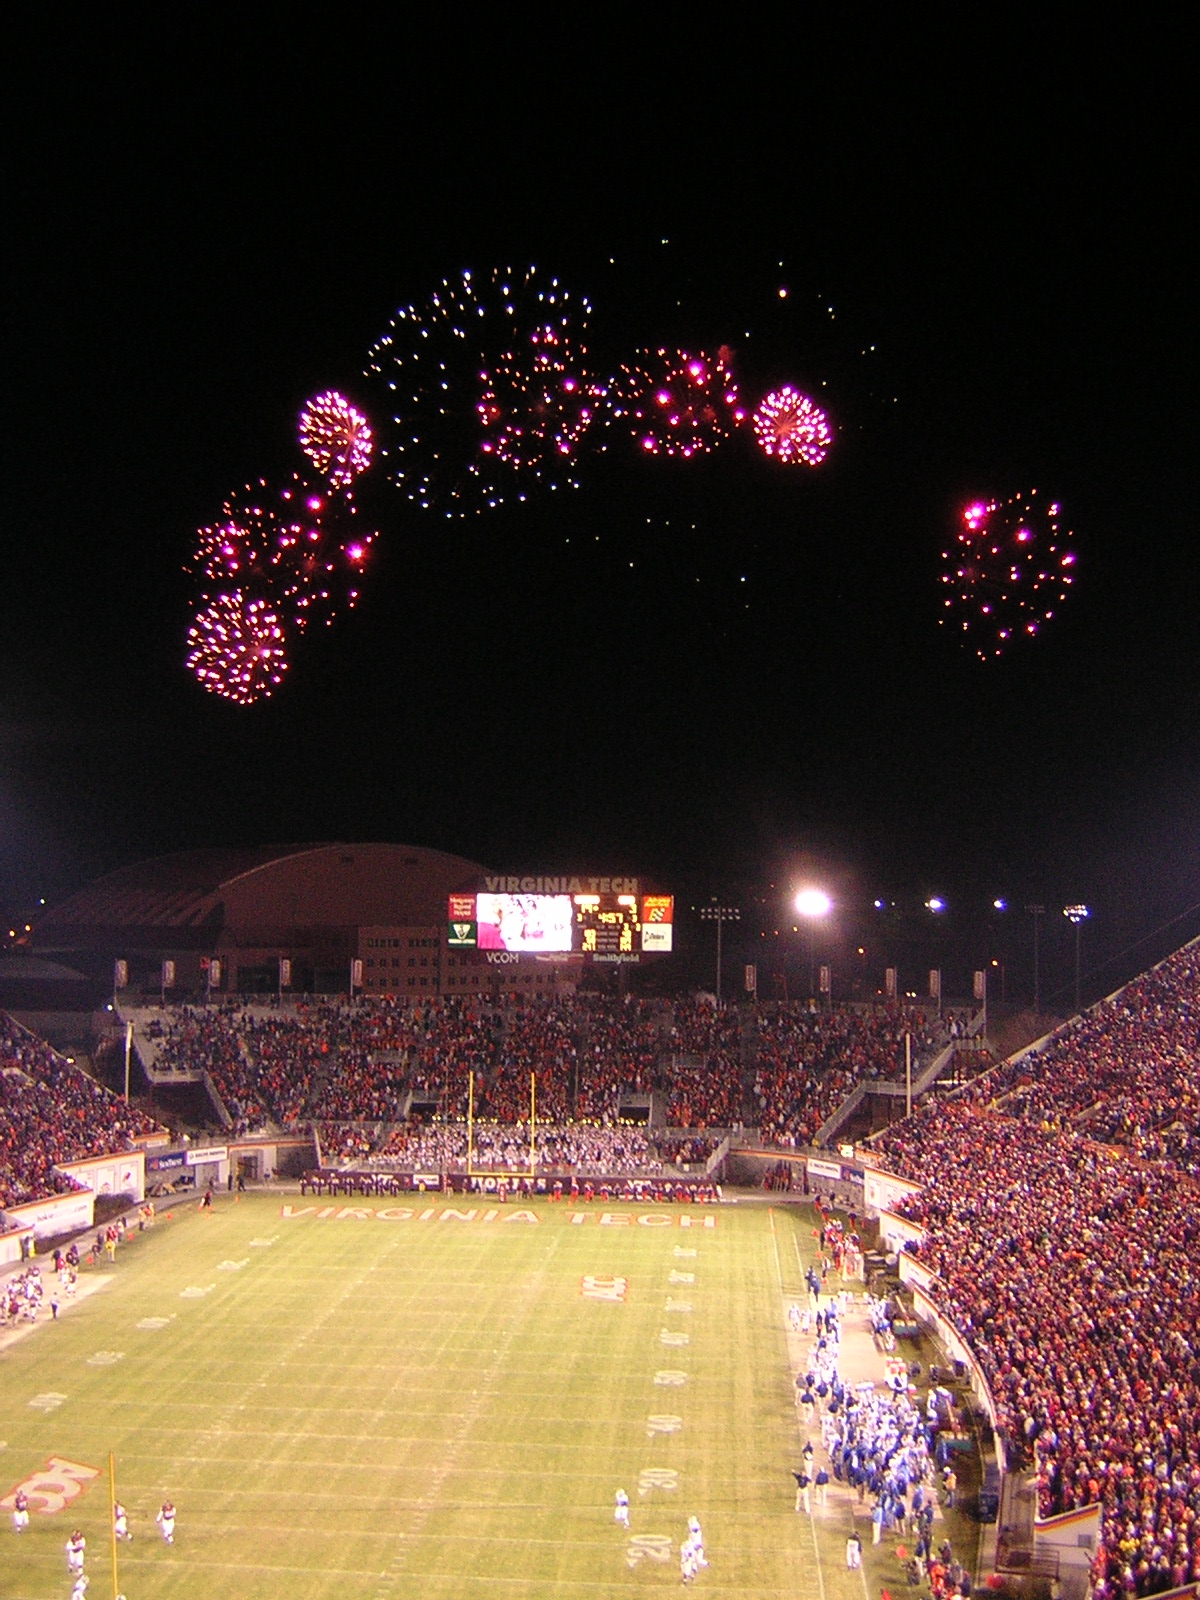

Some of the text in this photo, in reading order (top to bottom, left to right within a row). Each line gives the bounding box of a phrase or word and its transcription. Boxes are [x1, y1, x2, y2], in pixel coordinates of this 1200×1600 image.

[485, 876, 638, 894] VIRGINIA TECH
[486, 952, 519, 964] VCOM
[593, 952, 640, 965] Smithfield
[282, 1206, 717, 1227] VIRGINIA TECH
